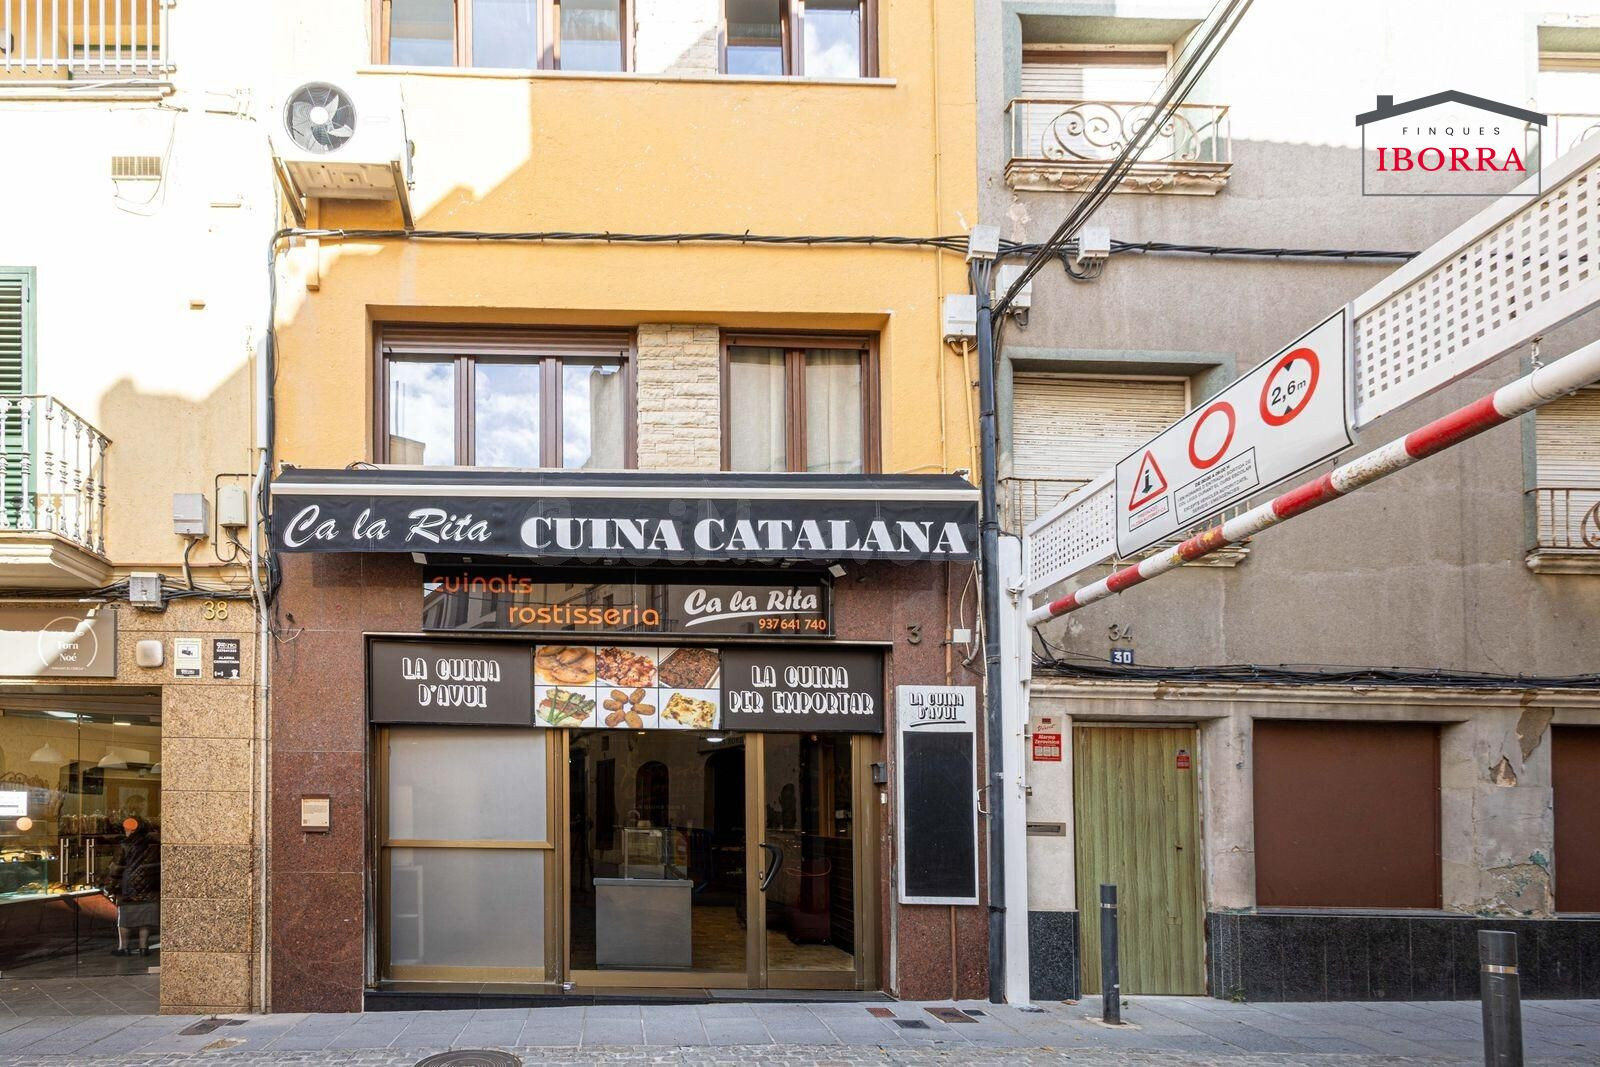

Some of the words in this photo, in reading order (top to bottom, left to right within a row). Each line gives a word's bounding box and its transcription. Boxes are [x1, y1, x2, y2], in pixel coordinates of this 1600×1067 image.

[282, 504, 340, 548] Ca
[352, 507, 391, 541] la
[405, 507, 492, 544] Rita
[520, 516, 685, 552] CUINA
[693, 517, 970, 555] CATALANA
[431, 572, 533, 595] cuinats
[202, 600, 228, 620] 38
[684, 588, 722, 615] Ca
[729, 590, 757, 612] la
[766, 589, 818, 611] Rita
[509, 603, 659, 626] rostisseria
[804, 618, 827, 631] 740
[906, 624, 922, 645] 3
[1108, 623, 1133, 642] 34
[59, 652, 77, 662] Noé
[1113, 651, 1132, 664] 30
[402, 657, 428, 680] LA
[435, 658, 501, 682] CUINA
[751, 665, 777, 688] LA
[784, 665, 849, 689] CUINA
[418, 683, 488, 708] D'AVUI
[728, 690, 764, 714] PER
[771, 690, 875, 715] EMPORTAR
[909, 692, 924, 706] LA
[927, 692, 965, 707] CUINA
[917, 706, 958, 720] D'AVUI
